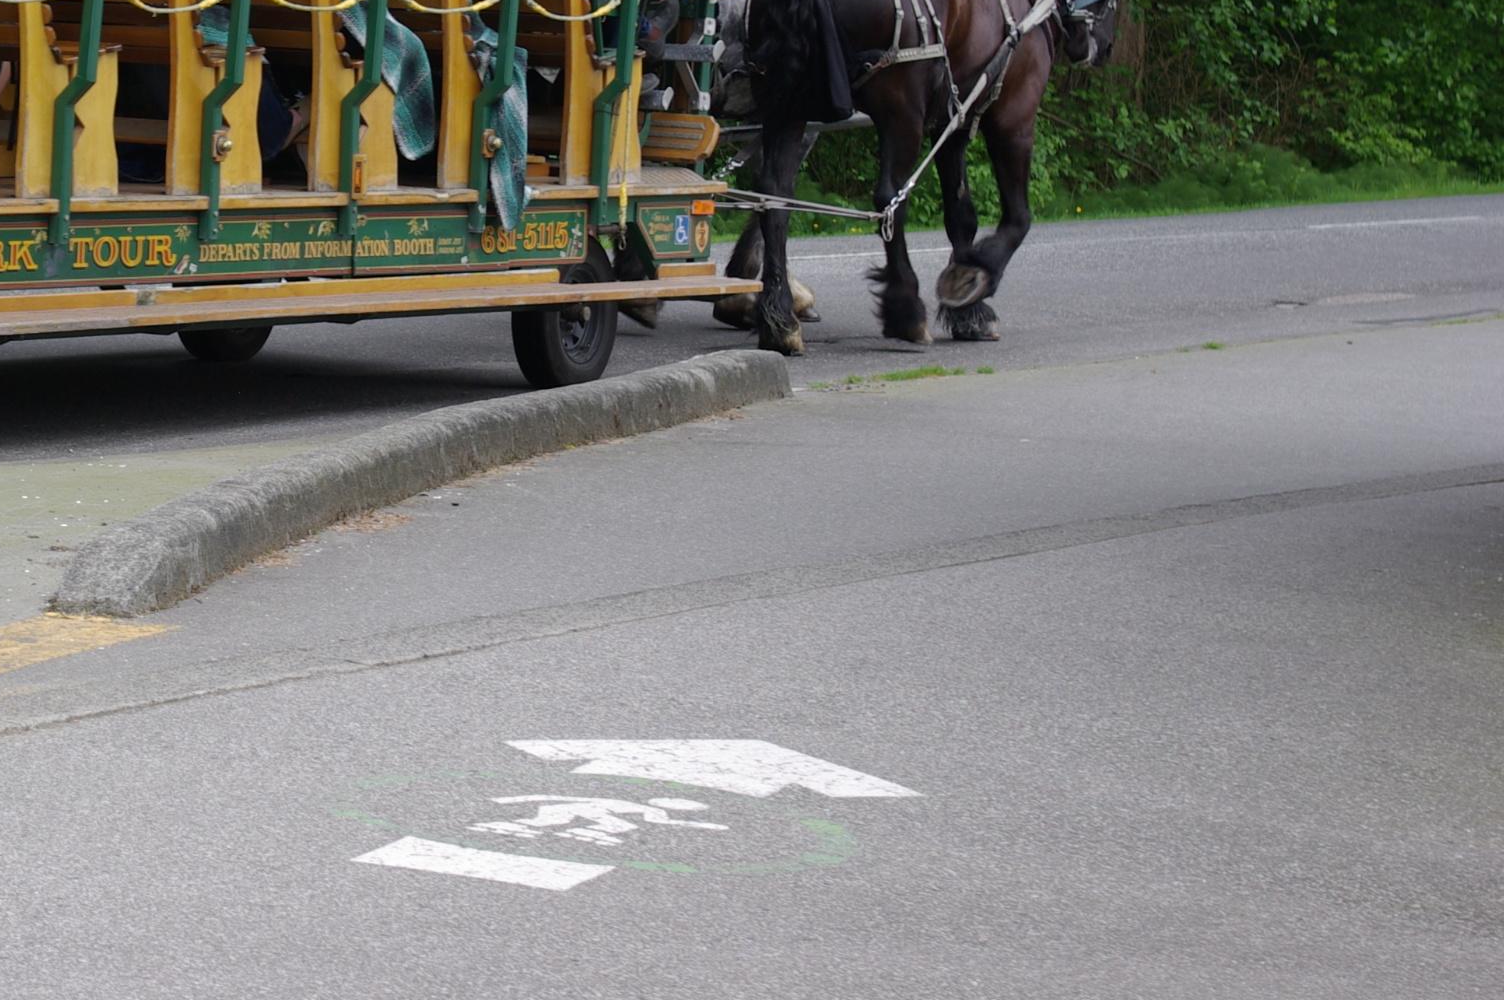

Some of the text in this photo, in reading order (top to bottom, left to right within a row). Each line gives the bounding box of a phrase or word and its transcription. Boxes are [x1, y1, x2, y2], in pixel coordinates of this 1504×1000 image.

[69, 235, 177, 268] TOUR
[199, 242, 260, 262] DEPARTS
[263, 241, 301, 260] FROM
[394, 237, 434, 256] BOOTH
